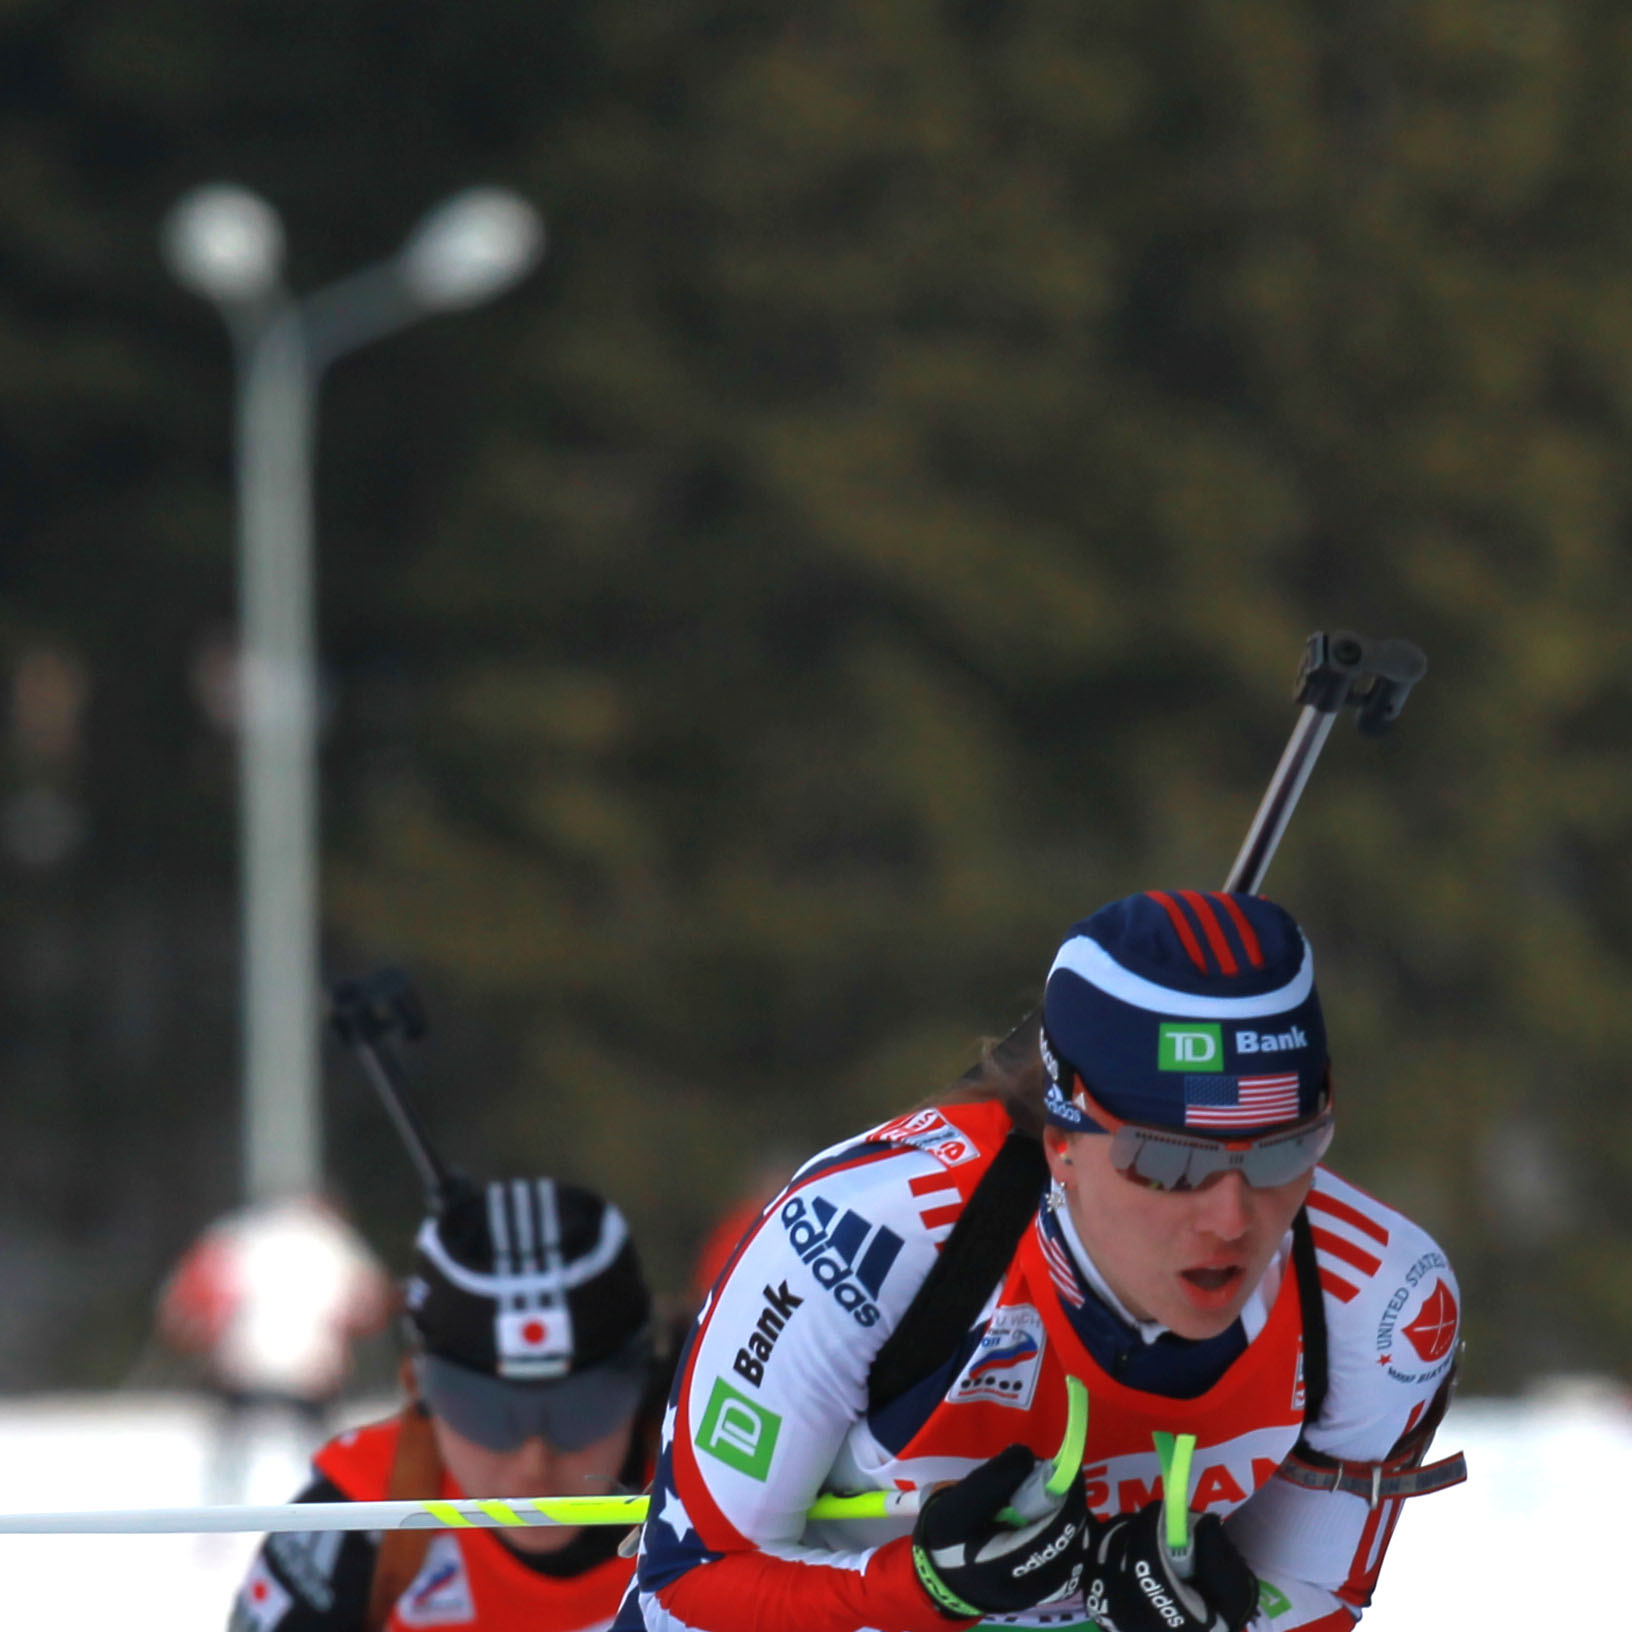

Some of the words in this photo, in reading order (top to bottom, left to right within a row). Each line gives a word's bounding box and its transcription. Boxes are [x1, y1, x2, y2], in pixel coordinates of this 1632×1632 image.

[1165, 1032, 1216, 1062] TD
[1235, 1026, 1308, 1054] Bank
[781, 1196, 881, 1328] adidas
[733, 1280, 804, 1388] Bank
[1376, 1287, 1409, 1350] UNITED
[709, 1397, 763, 1457] TD
[1011, 1522, 1076, 1568] adidas
[1134, 1560, 1185, 1628] adidas
